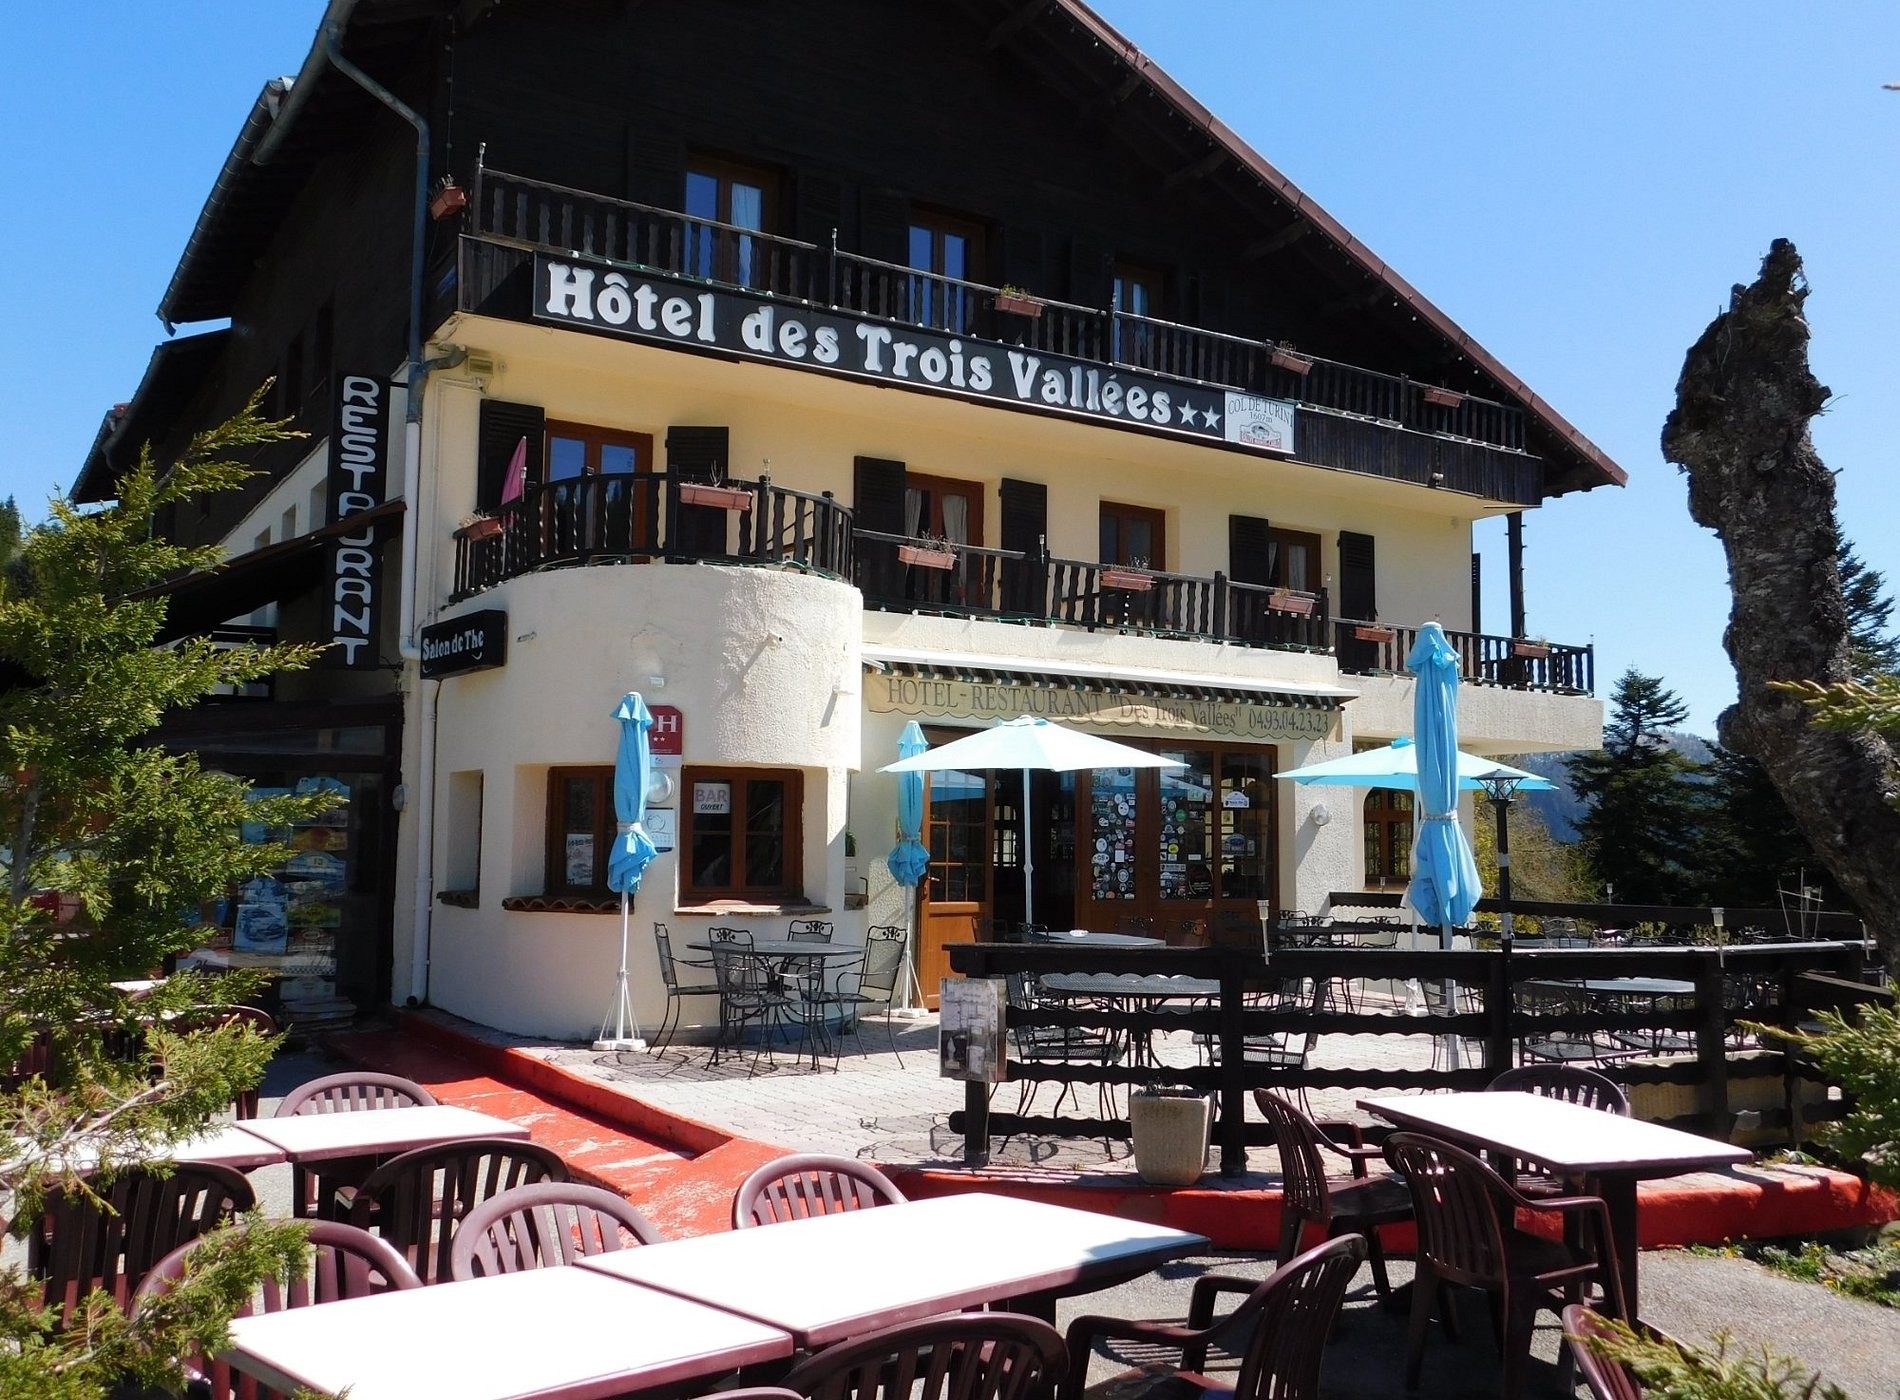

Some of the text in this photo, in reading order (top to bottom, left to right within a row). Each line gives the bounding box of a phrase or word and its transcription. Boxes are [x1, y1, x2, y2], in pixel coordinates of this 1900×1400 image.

[546, 263, 1172, 424] Hôtel des Trois Vallées
[1228, 397, 1293, 428] COL DE TURINI
[422, 628, 485, 661] Salon de The
[887, 678, 958, 708] HOTEL
[971, 684, 1103, 716] RESTAURANT
[1151, 699, 1187, 723] Trois
[656, 714, 677, 732] H
[695, 789, 728, 802] BAR
